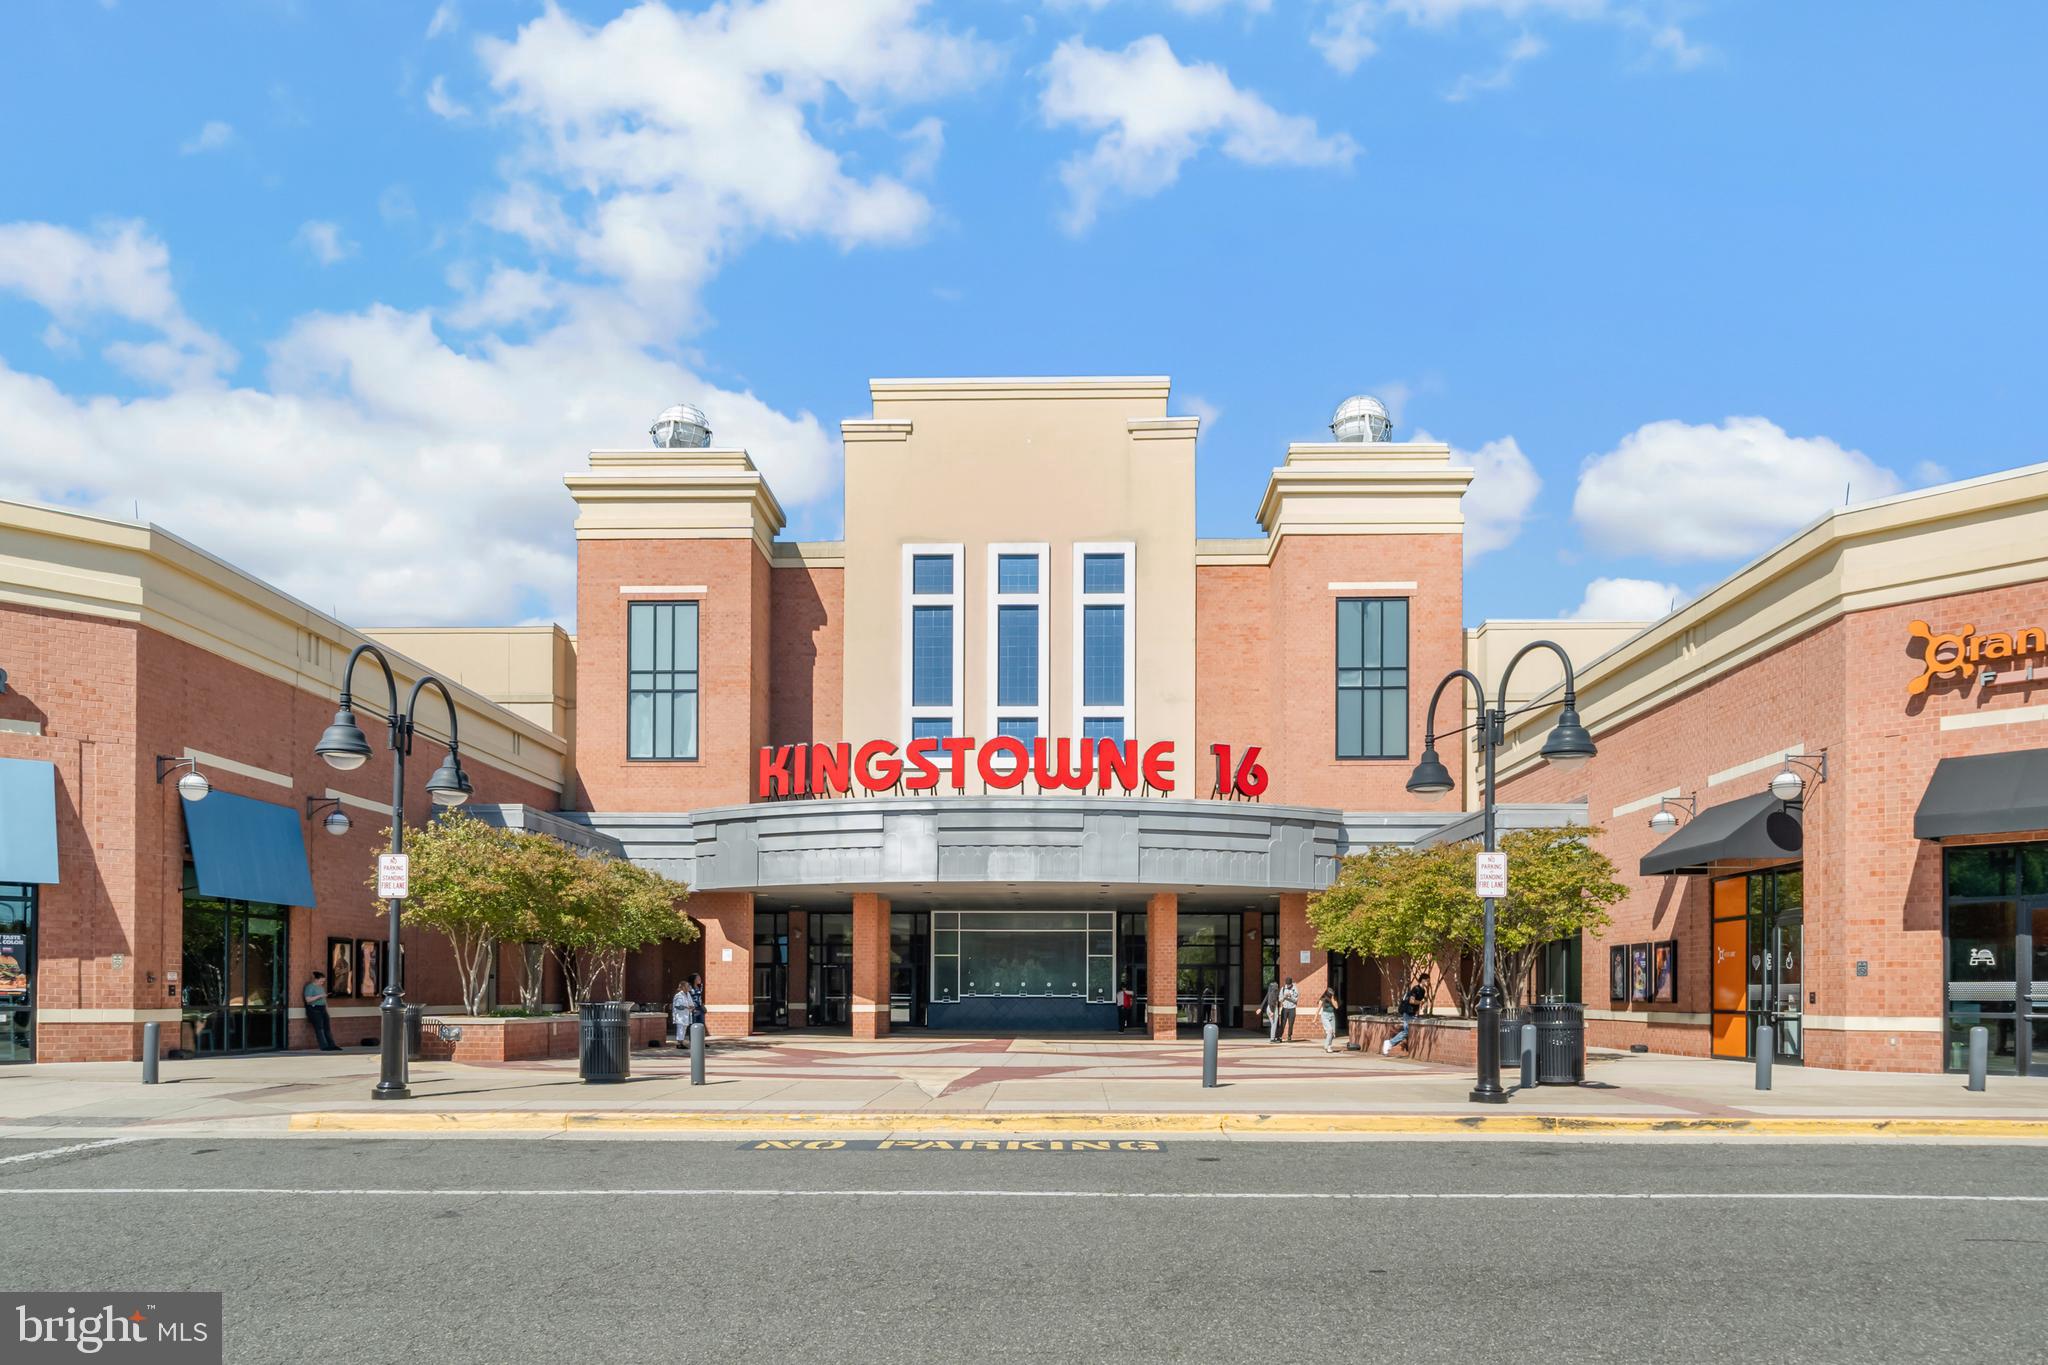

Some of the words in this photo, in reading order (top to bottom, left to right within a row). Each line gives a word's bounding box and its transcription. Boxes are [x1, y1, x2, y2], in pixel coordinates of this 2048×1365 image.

[760, 736, 1175, 798] KINGSTOWNE
[1211, 744, 1269, 797] 16
[754, 1140, 847, 1150] NO
[876, 1140, 1162, 1151] PARKING
